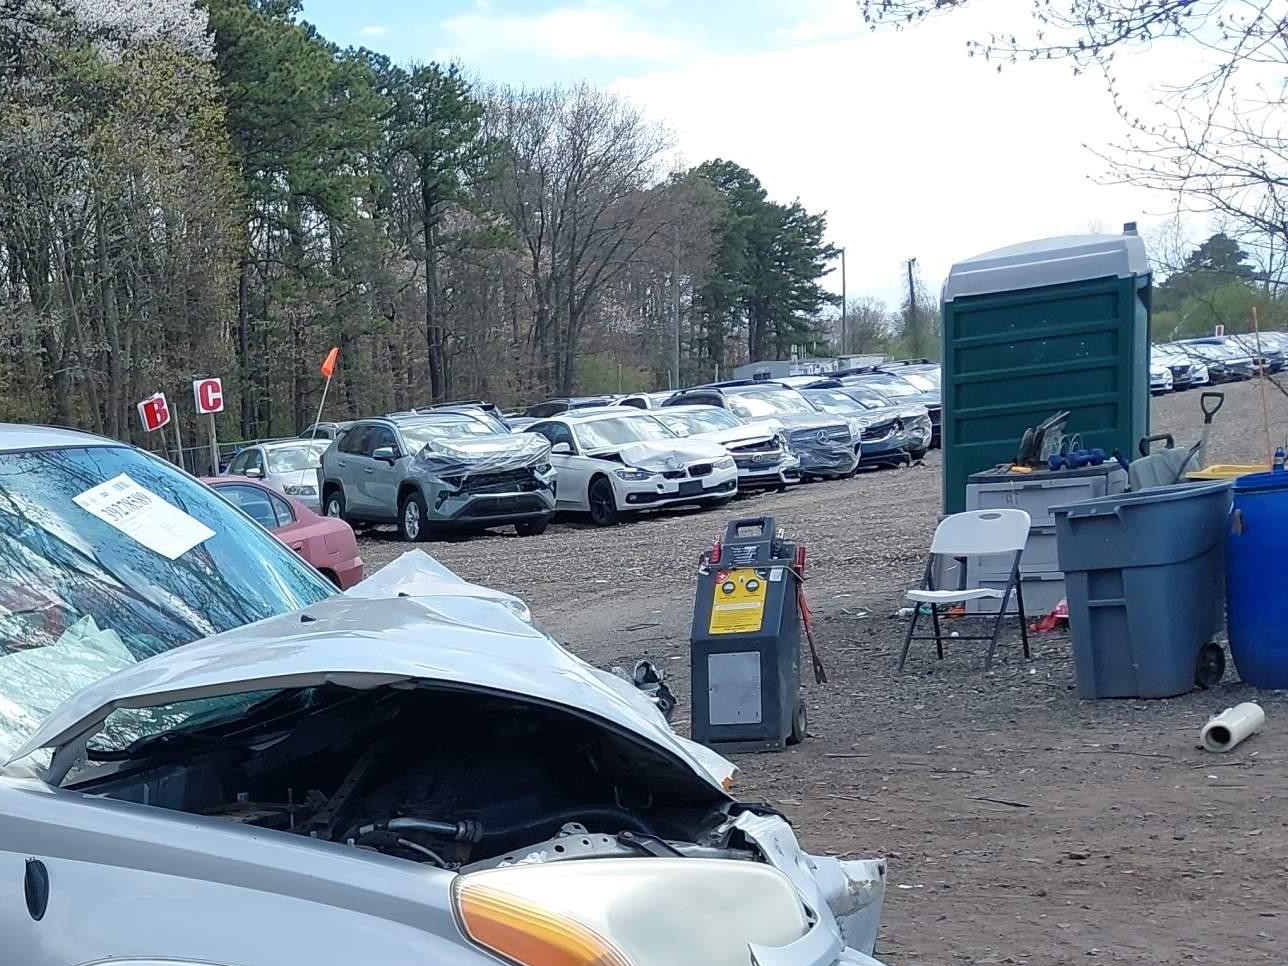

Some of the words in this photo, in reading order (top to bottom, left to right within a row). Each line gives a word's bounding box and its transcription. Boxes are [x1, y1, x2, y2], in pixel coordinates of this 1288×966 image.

[199, 381, 222, 411] C
[143, 398, 168, 428] B
[100, 491, 153, 521] 39278589
